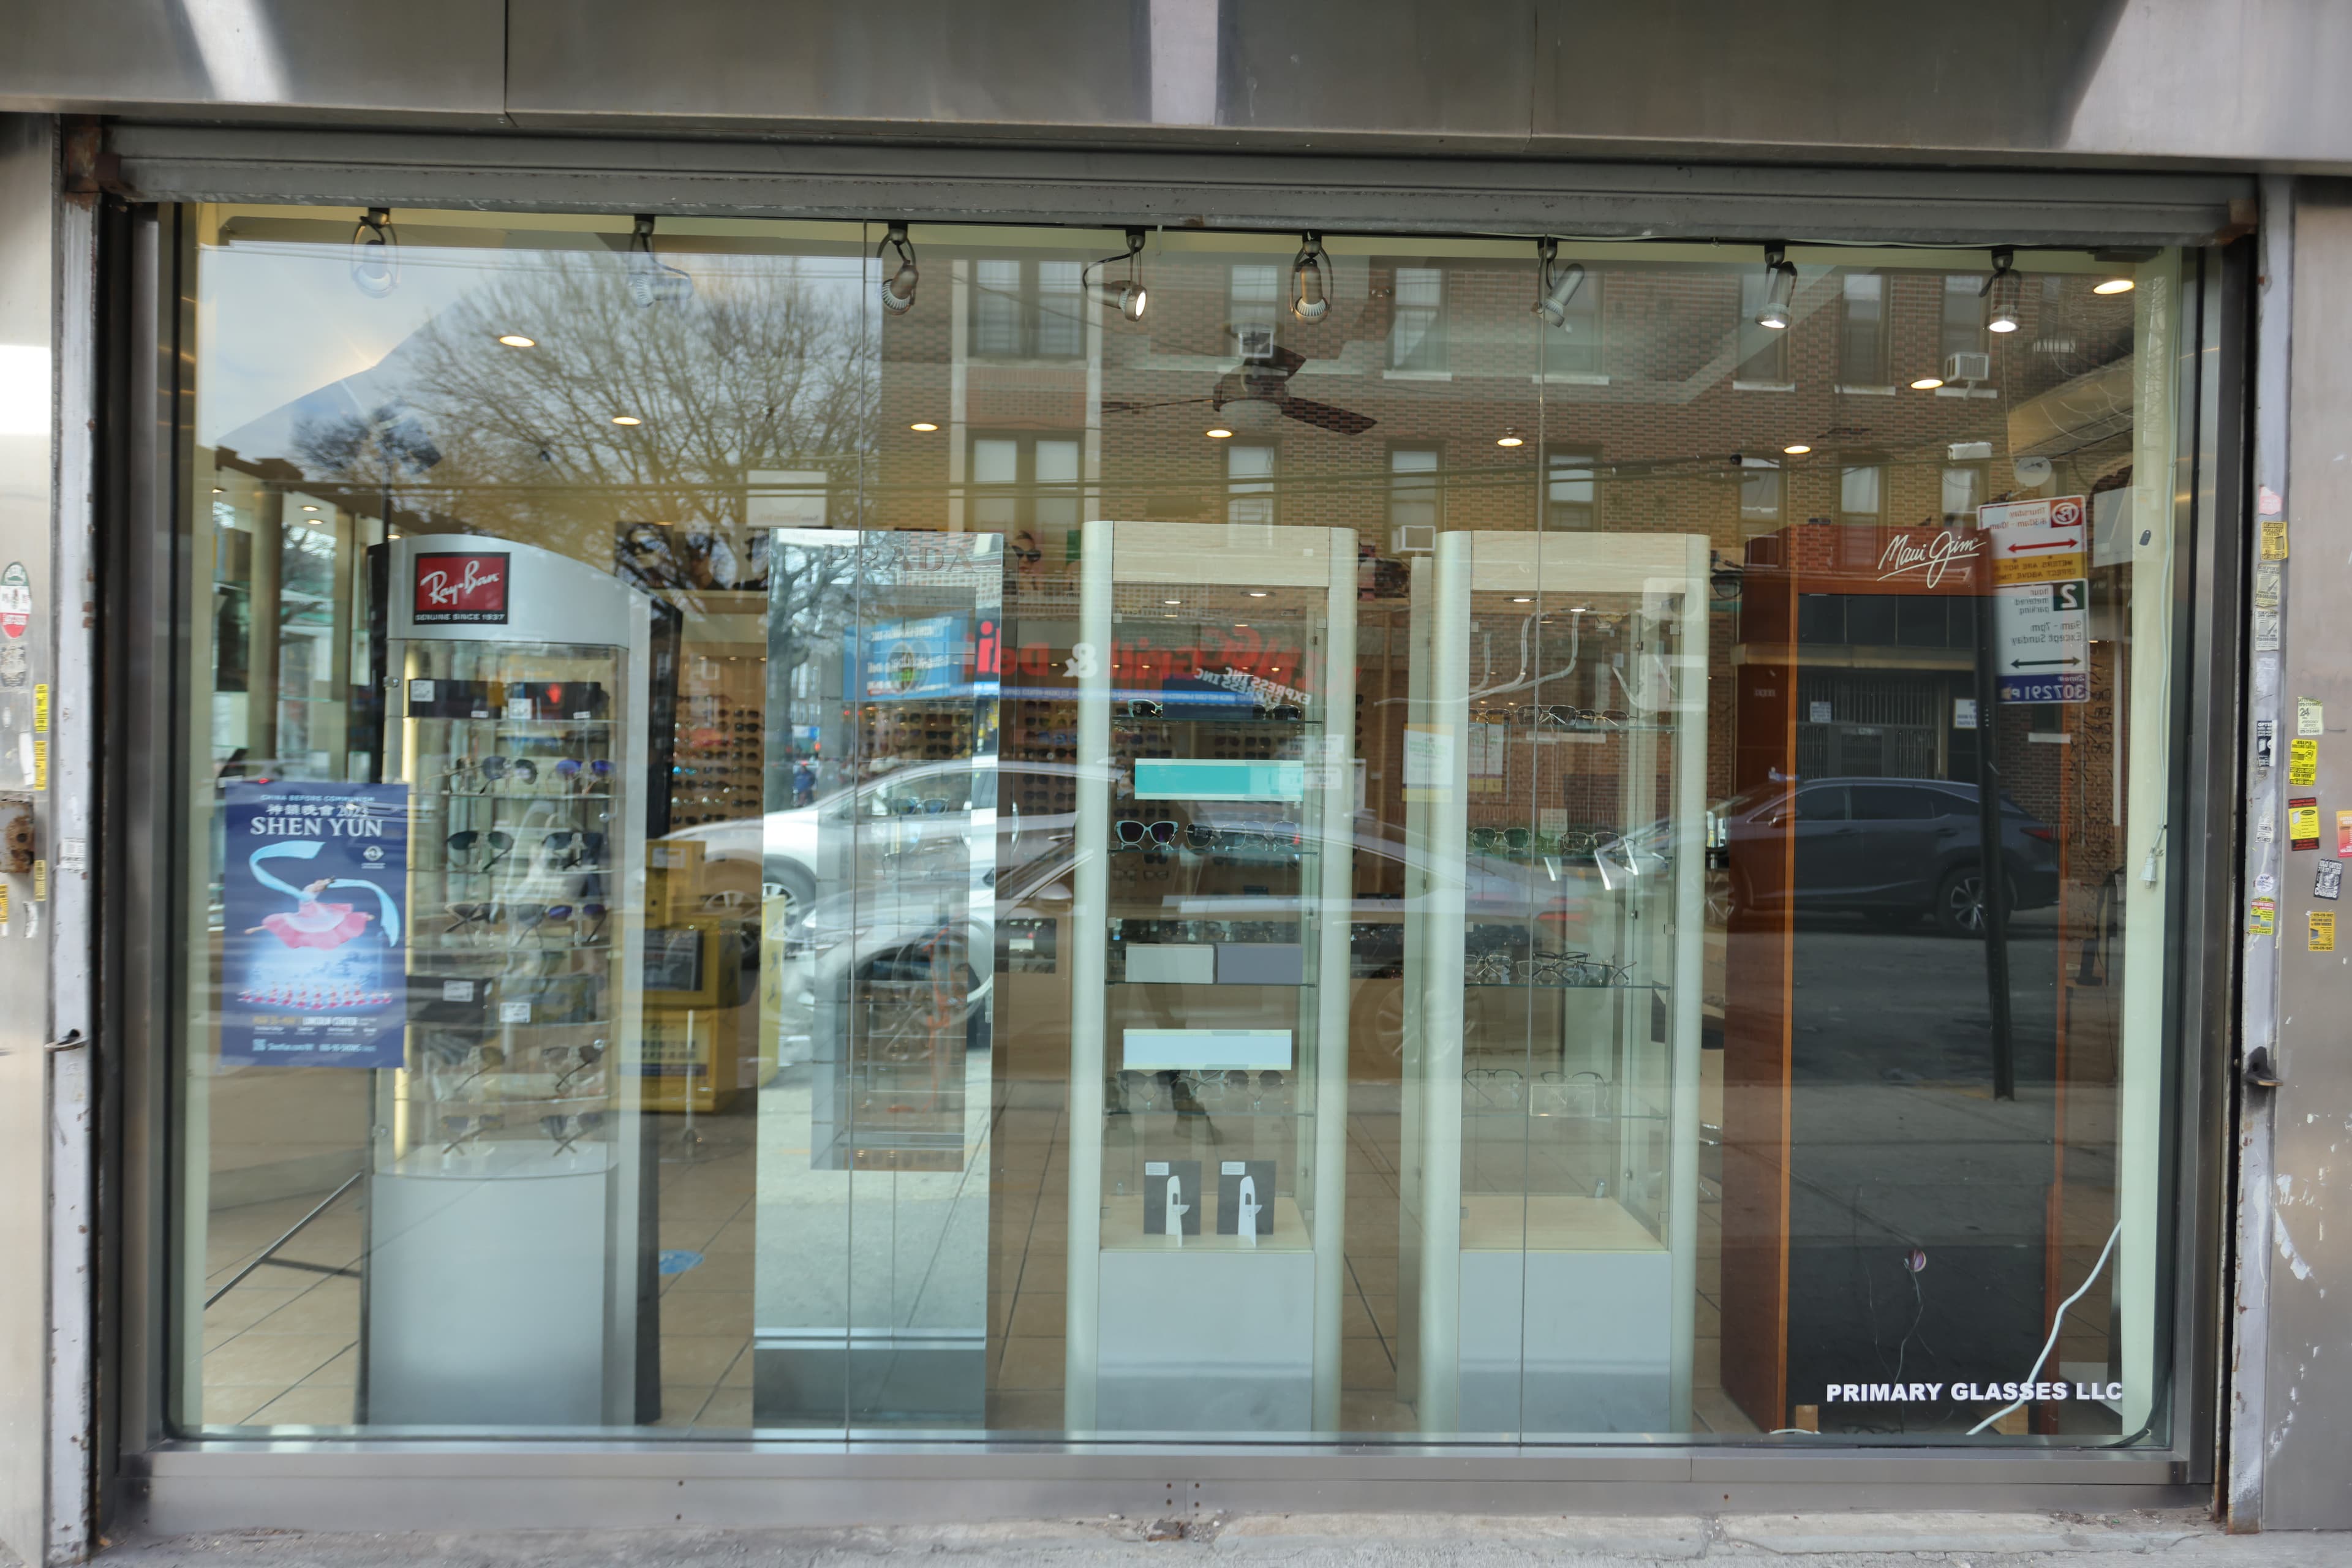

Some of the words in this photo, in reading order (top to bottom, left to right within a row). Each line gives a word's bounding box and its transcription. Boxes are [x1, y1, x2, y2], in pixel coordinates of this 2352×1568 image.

[823, 543, 976, 574] PRADA
[1877, 534, 1926, 570] Maui
[2299, 707, 2310, 717] 24
[336, 805, 369, 818] 2023
[250, 816, 323, 837] SHEN
[328, 818, 383, 837] YUN
[1826, 1382, 1944, 1402] PRIMARY
[1950, 1382, 2068, 1401] GLASSES
[2076, 1382, 2122, 1401] LLC
